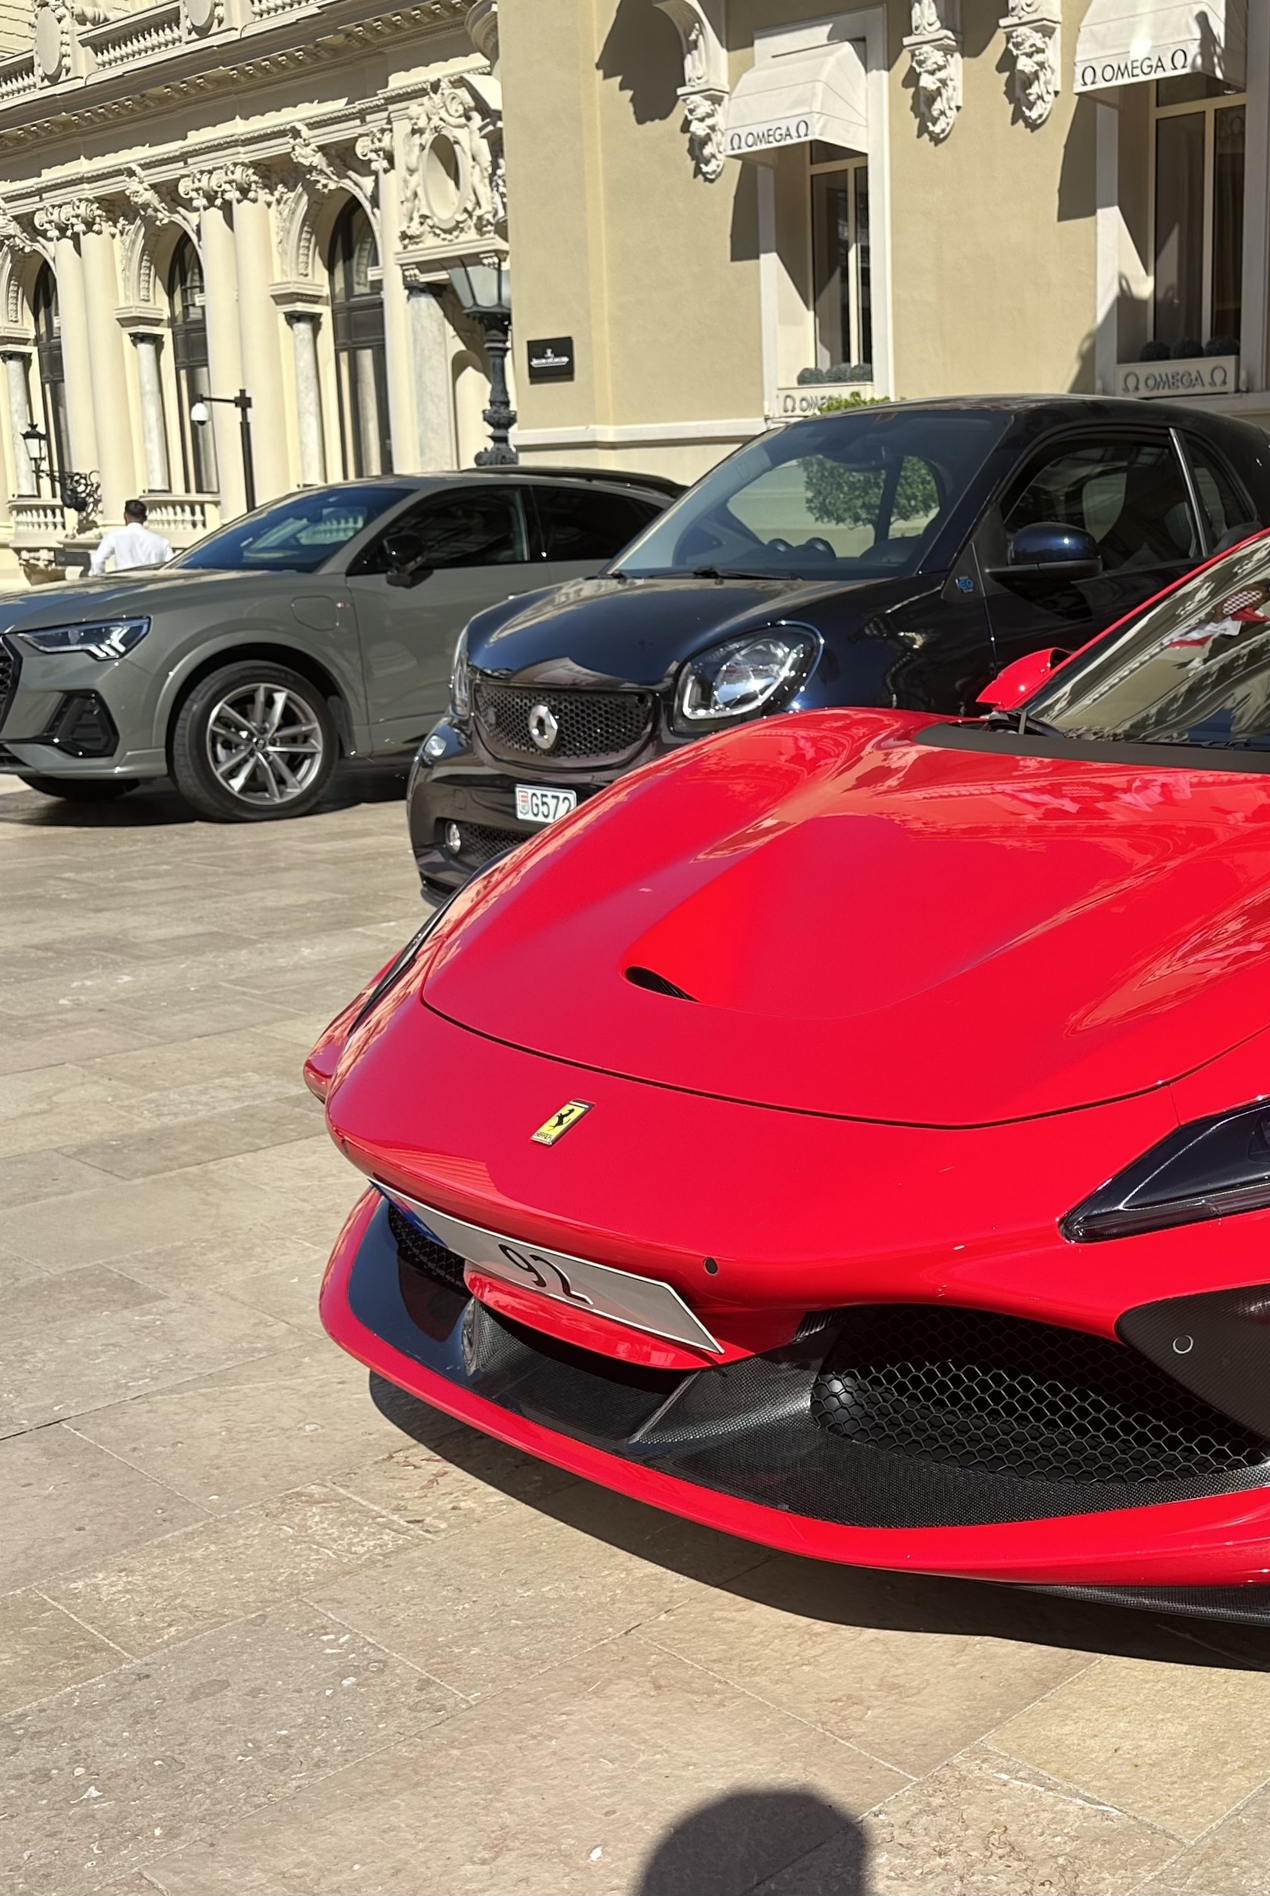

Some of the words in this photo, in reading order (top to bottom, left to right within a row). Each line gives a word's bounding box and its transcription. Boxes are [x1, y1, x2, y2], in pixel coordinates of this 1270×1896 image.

[1101, 55, 1166, 82] OMEGA
[745, 126, 793, 148] OMEGA
[1144, 369, 1205, 392] OMEGA
[531, 792, 572, 820] G572
[498, 1243, 593, 1305] 92
